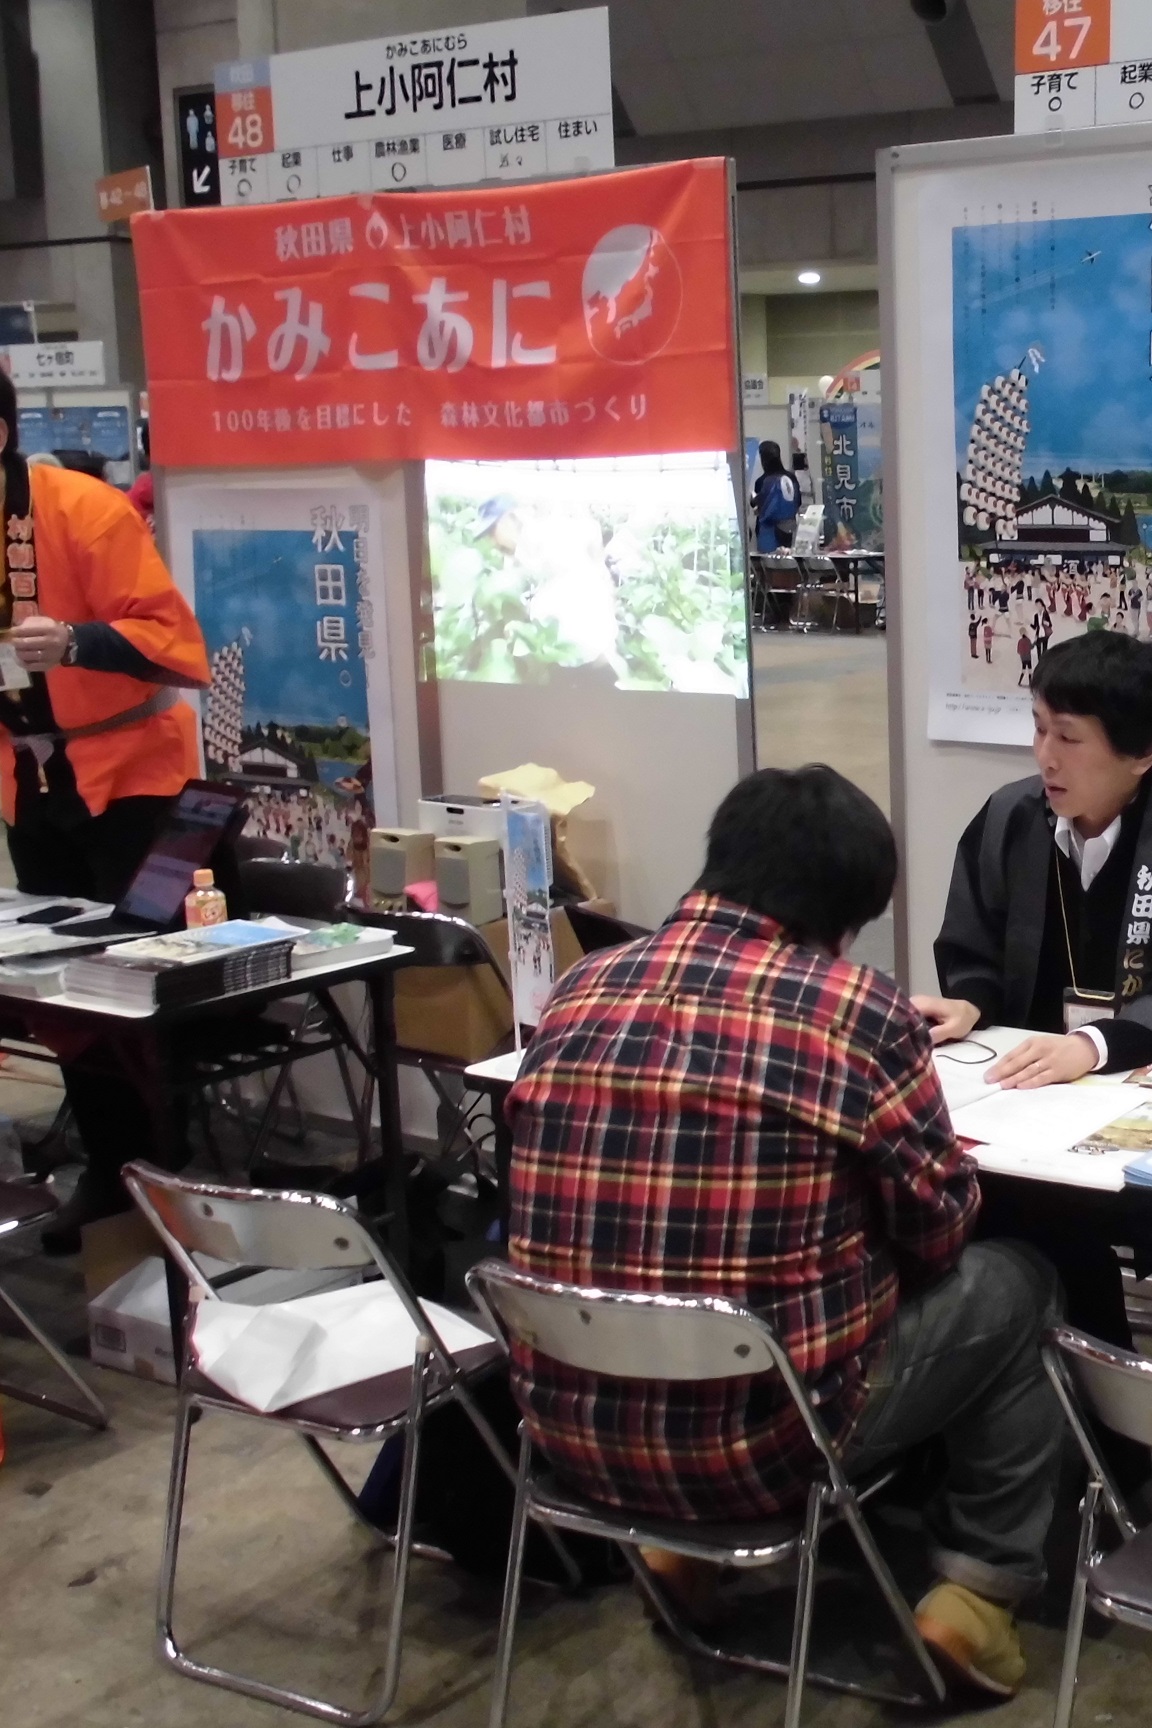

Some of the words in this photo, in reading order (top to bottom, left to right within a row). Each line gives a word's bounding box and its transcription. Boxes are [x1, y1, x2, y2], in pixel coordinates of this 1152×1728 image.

[385, 33, 468, 60] かみこあにむら
[1032, 16, 1092, 62] 47
[344, 49, 518, 119] 上小阿仁村
[1030, 71, 1080, 95] 子育て
[228, 113, 264, 149] 48
[489, 125, 540, 146] 試し住宅
[558, 120, 598, 139] 住まい
[275, 216, 355, 262] 秋田県
[394, 205, 533, 251] 上小阿仁村
[201, 276, 558, 383] かみこあに
[833, 434, 858, 522] 北見市
